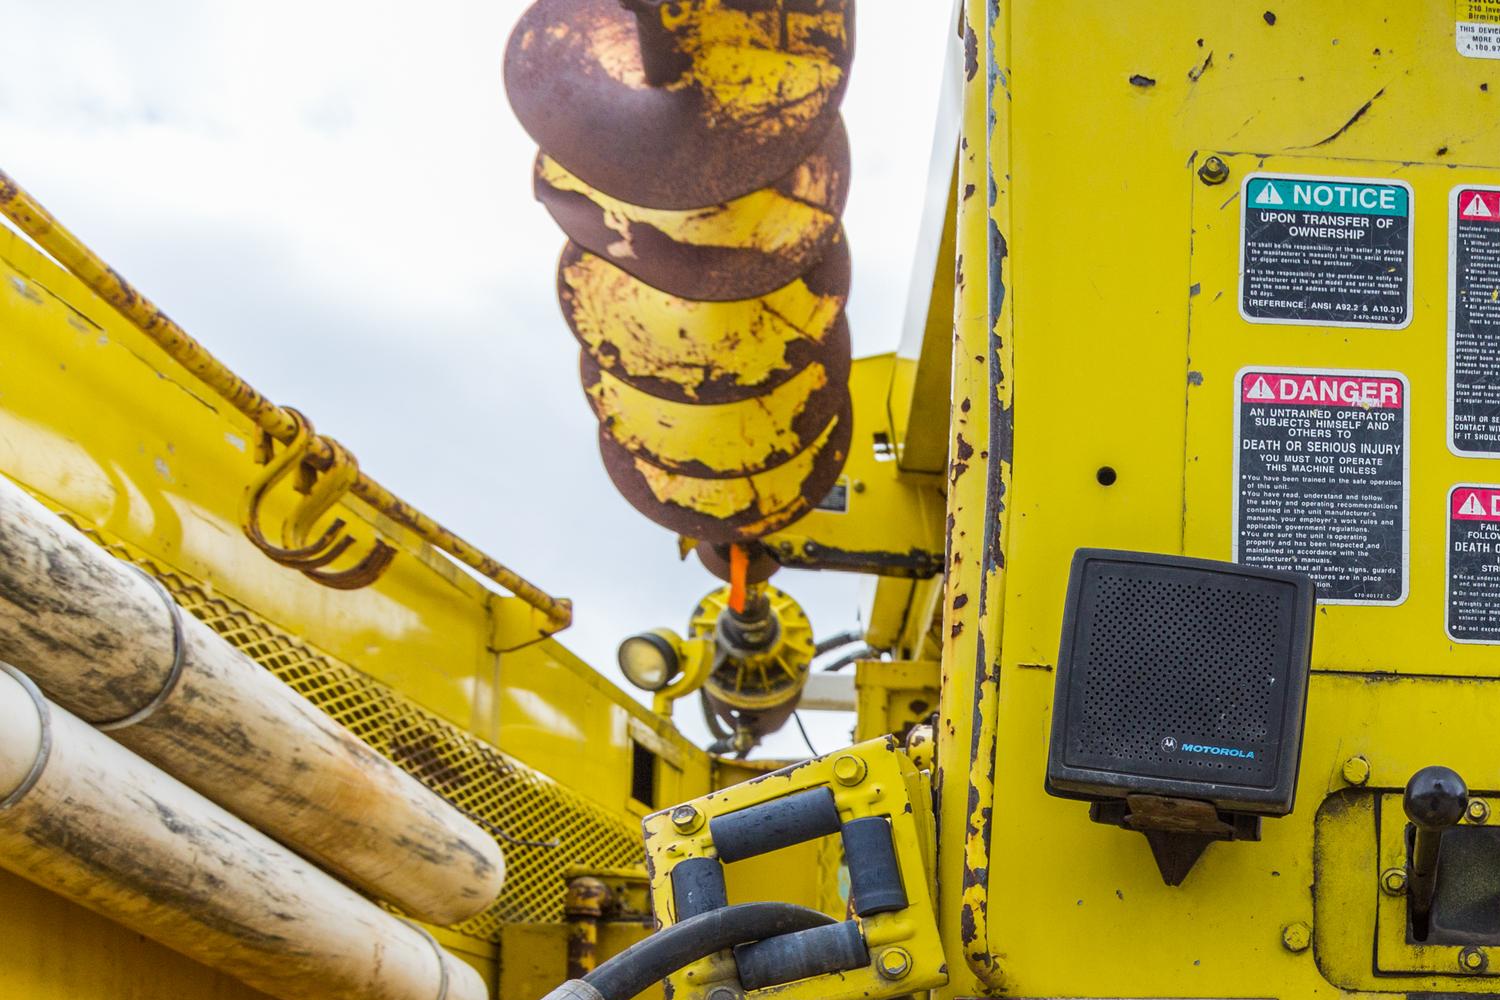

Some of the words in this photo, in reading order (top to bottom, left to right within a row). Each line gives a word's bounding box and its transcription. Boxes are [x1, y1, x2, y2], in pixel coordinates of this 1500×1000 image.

[1294, 185, 1396, 209] NOTICE
[1261, 213, 1296, 223] UPON
[1303, 215, 1369, 227] TRANSFER
[1377, 218, 1394, 228] OF
[1289, 228, 1365, 239] OWNERSHIP
[1336, 303, 1358, 311] A92.2
[1280, 379, 1398, 404] DANGER
[1250, 408, 1265, 416] AN
[1270, 409, 1331, 418] UNTRAINED
[1337, 411, 1395, 421] OPERATOR
[1255, 418, 1310, 427] SUBJECTS
[1316, 420, 1361, 429] HIMSELF
[1367, 422, 1389, 430] AND
[1289, 429, 1331, 437] OTHERS
[1338, 430, 1351, 438] TO
[1243, 440, 1281, 450] DEATH
[1286, 441, 1301, 451] OR
[1307, 442, 1356, 453] SERIOUS
[1361, 444, 1400, 454] INJURY
[1260, 454, 1280, 462] YOU
[1285, 455, 1309, 463] MUST
[1315, 456, 1335, 464] NOT
[1340, 457, 1382, 465] OPERATE
[1266, 463, 1286, 471] THIS
[1292, 464, 1334, 473] MACHINE
[1340, 466, 1376, 474] UNLESS
[1455, 542, 1490, 553] DEATH
[1182, 744, 1255, 759] MOTOROLA
